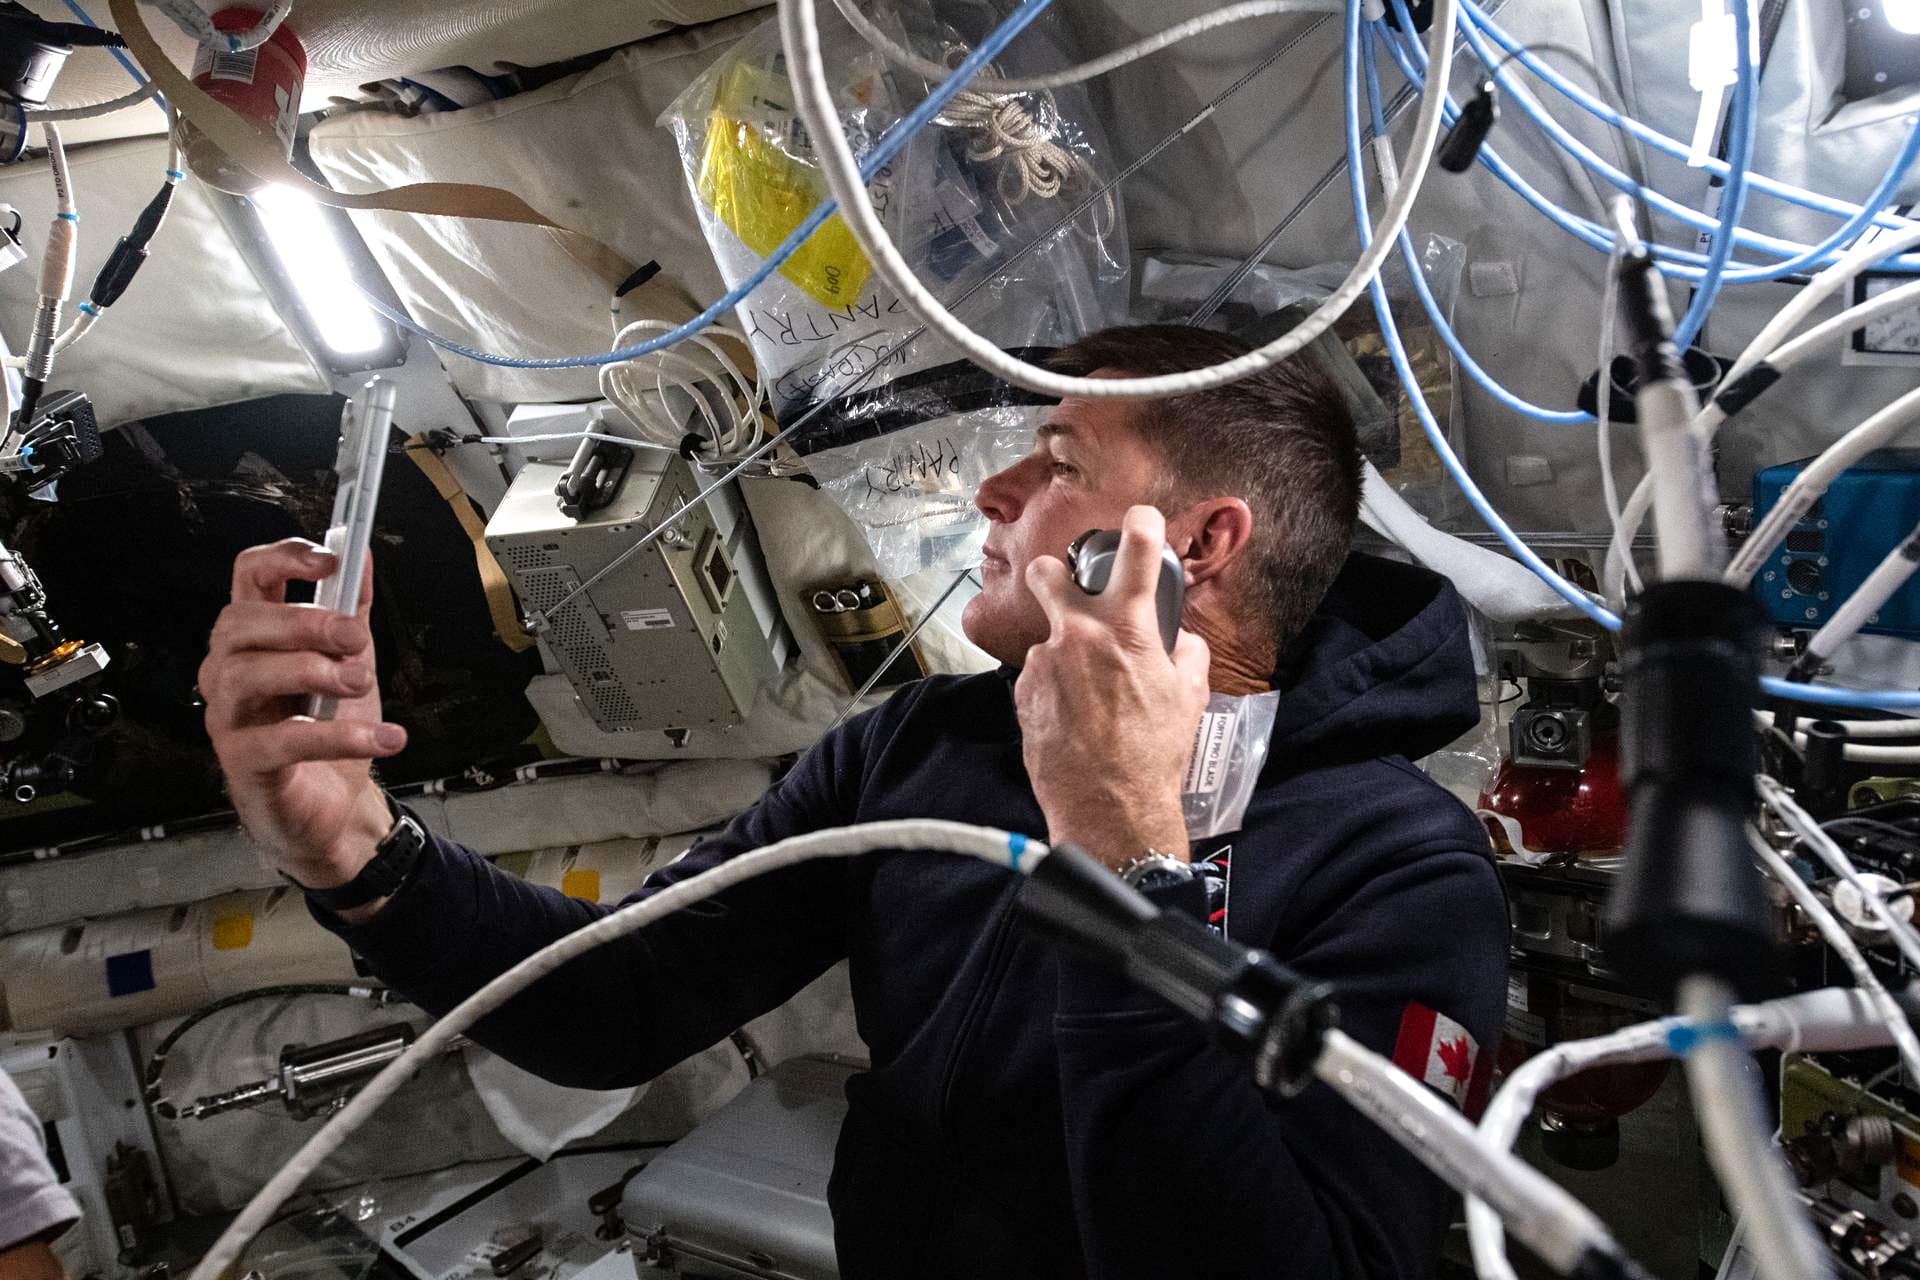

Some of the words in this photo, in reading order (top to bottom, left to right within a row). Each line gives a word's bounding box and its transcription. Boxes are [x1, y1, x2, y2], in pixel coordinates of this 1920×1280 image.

[1213, 716, 1228, 740] FORTE
[1210, 742, 1222, 759] PRO
[1204, 760, 1217, 787] BLADE
